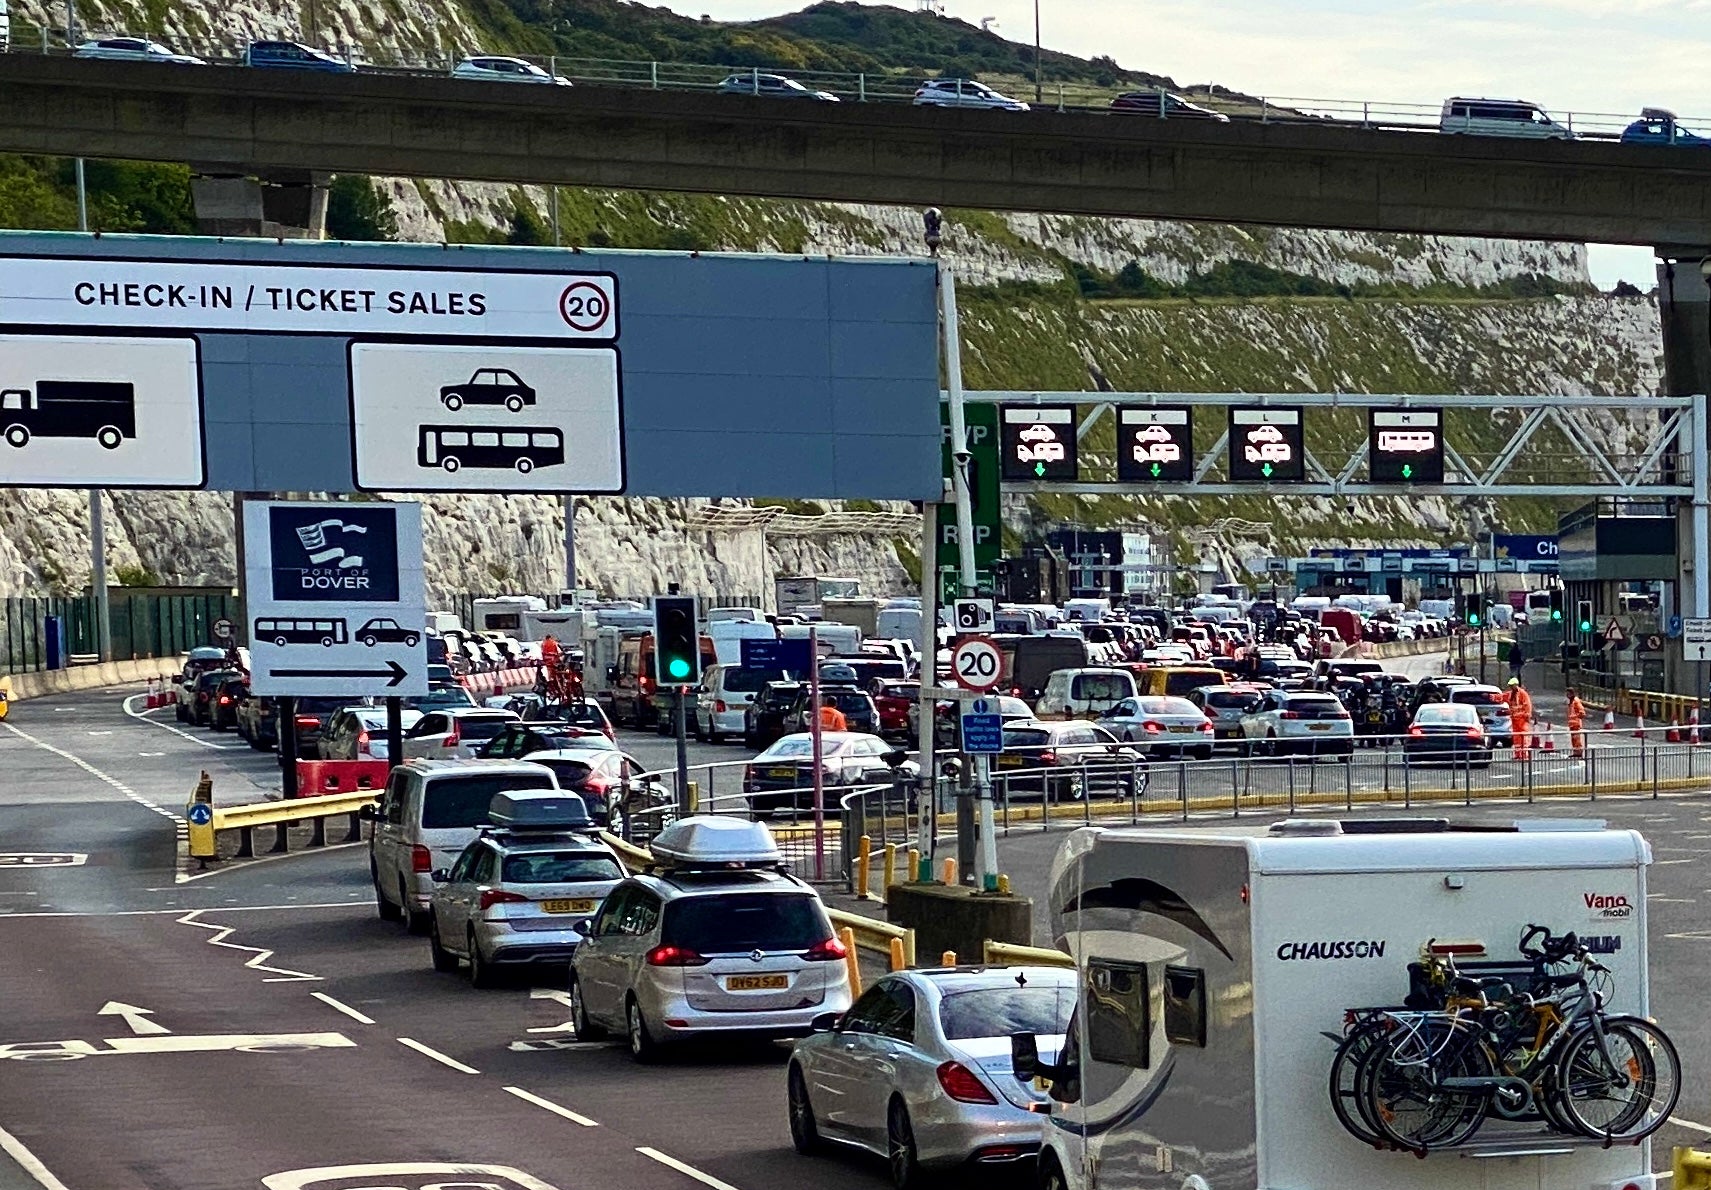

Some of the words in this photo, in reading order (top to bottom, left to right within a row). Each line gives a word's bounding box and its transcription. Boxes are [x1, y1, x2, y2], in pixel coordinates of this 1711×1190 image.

[73, 281, 233, 309] CHECK-IN
[264, 287, 376, 314] TICKET
[386, 290, 487, 317] SALES
[568, 295, 604, 318] 20
[943, 525, 991, 544] RP
[301, 568, 343, 576] PORT
[349, 568, 369, 577] OF
[301, 576, 370, 589] DOVER
[960, 651, 997, 677] 20
[1583, 893, 1628, 909] Vano
[1276, 940, 1386, 961] CHAUSSON
